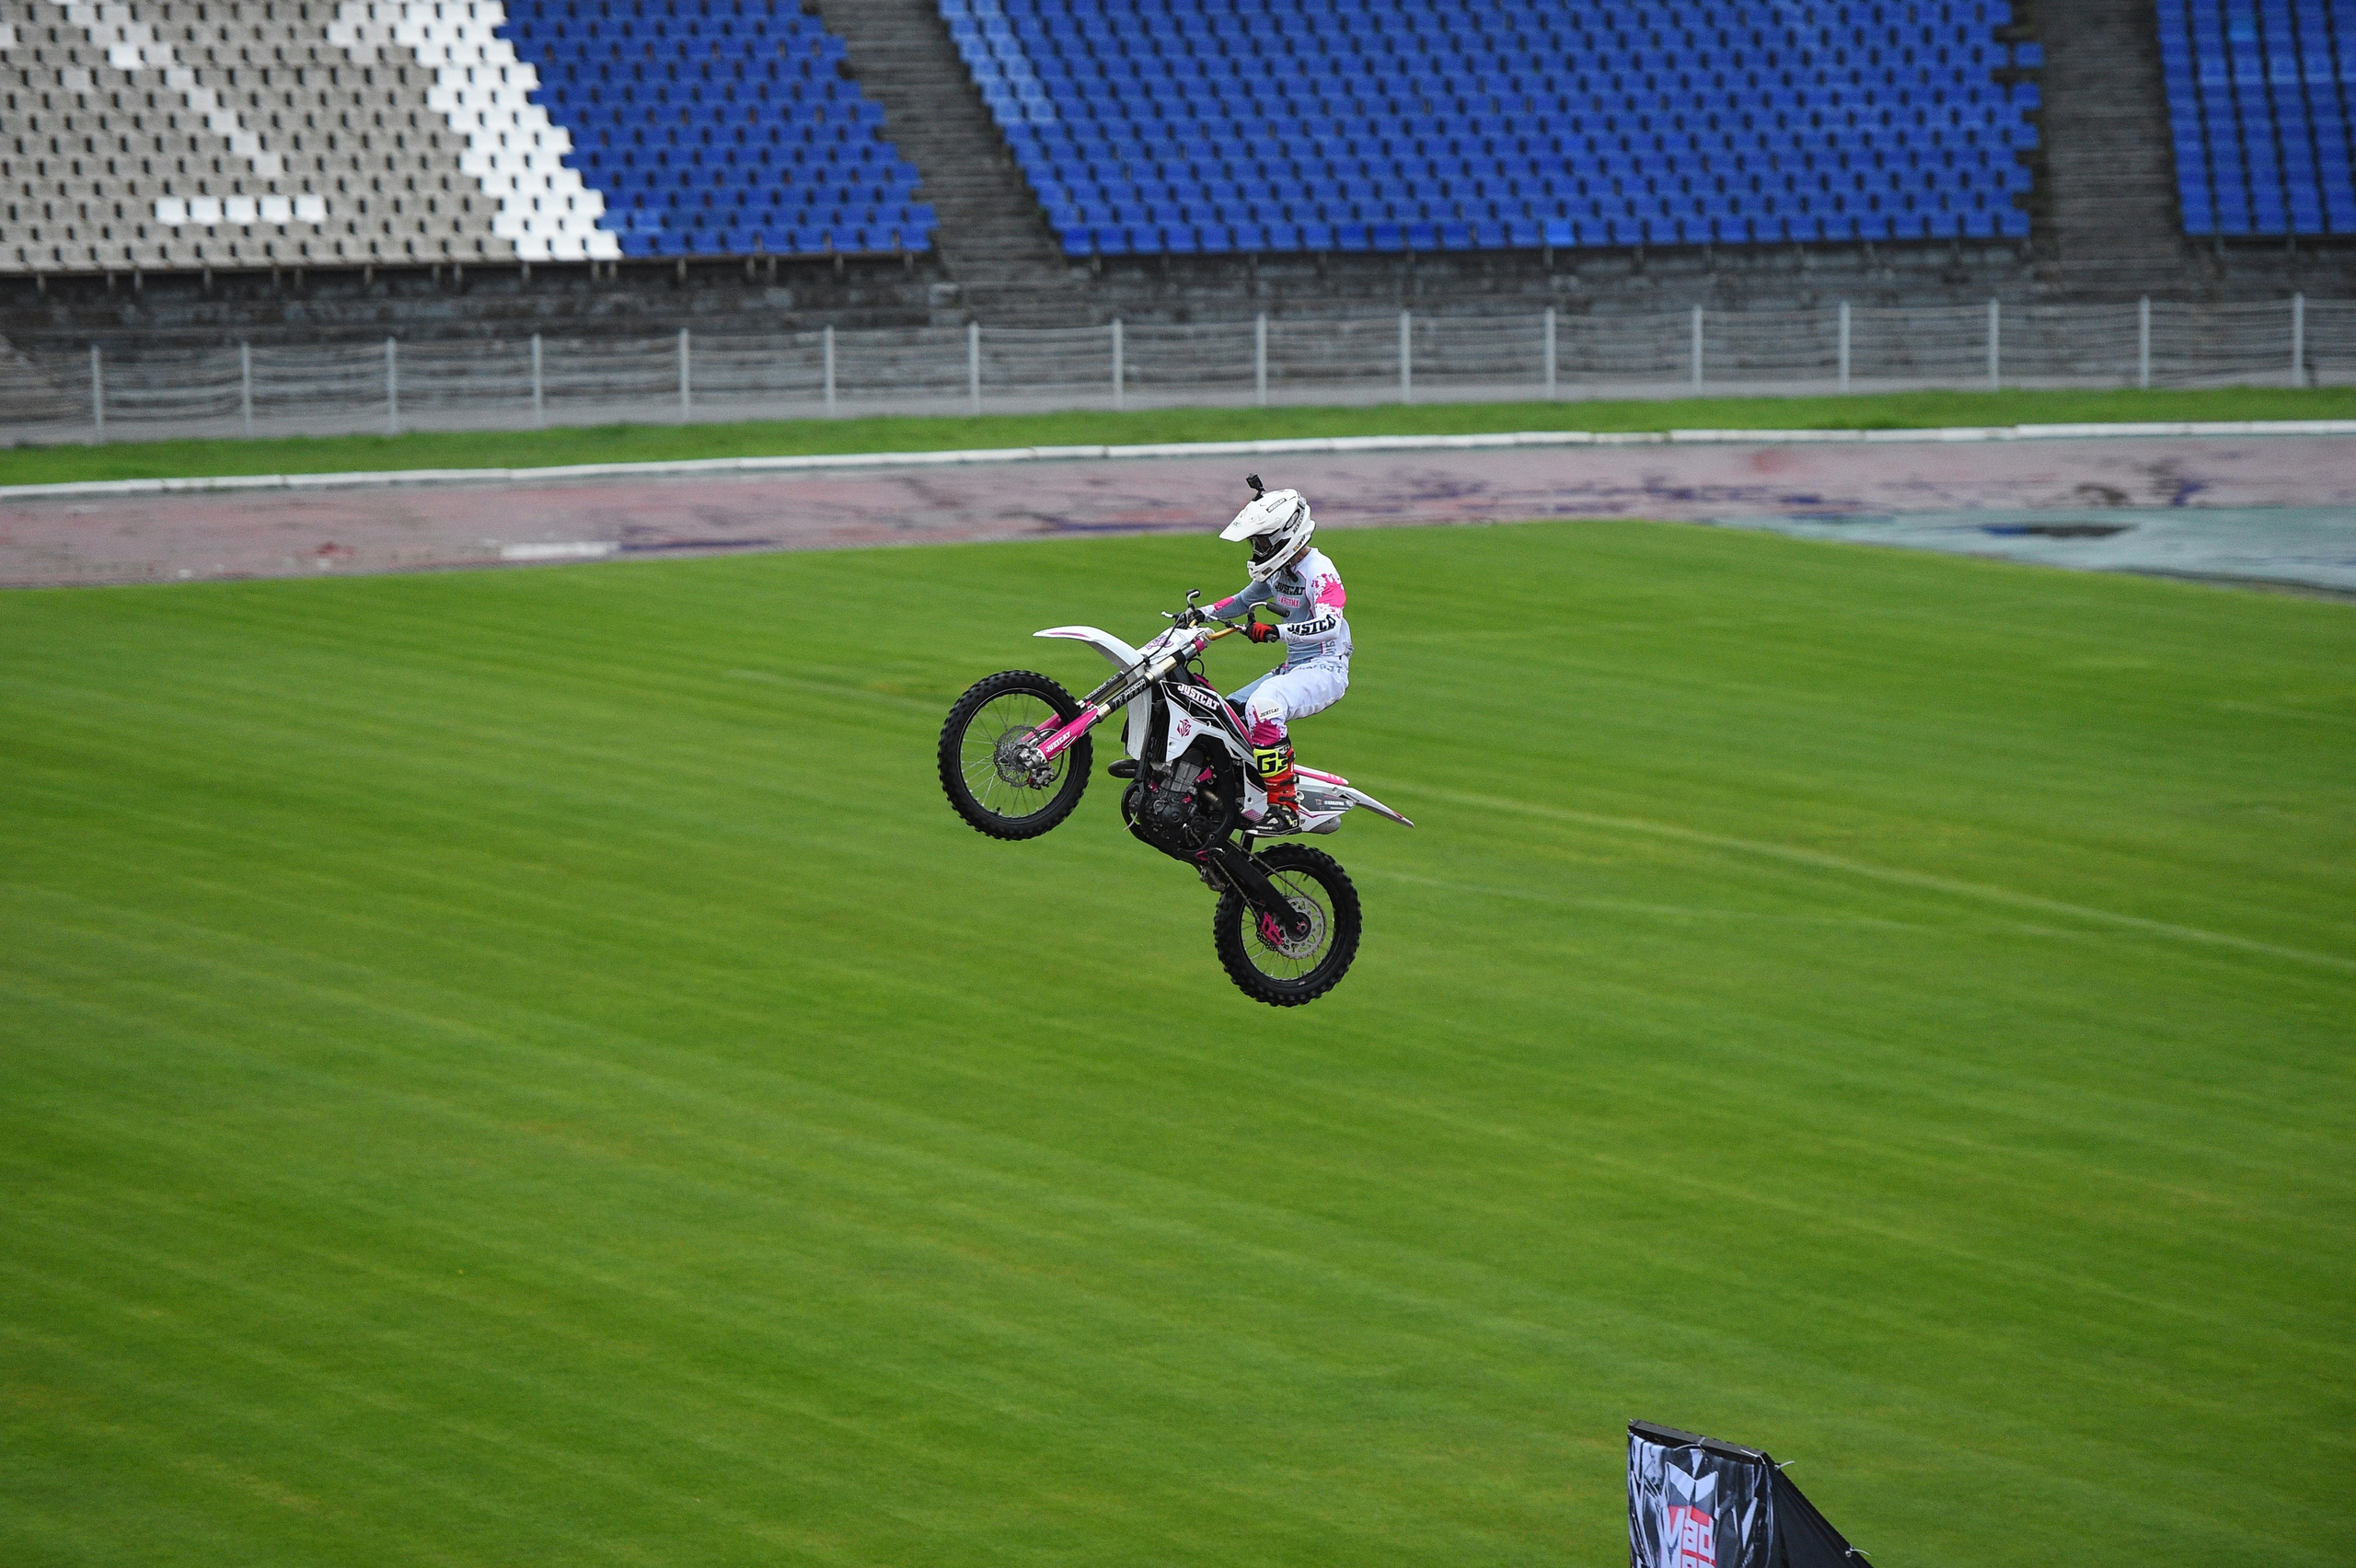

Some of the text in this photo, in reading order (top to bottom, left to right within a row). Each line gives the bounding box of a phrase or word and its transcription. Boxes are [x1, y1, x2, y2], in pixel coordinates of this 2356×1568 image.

[1275, 582, 1306, 595] JUSTCAT
[1177, 684, 1220, 710] JUSTCAT
[1045, 731, 1071, 753] JUSTCAT
